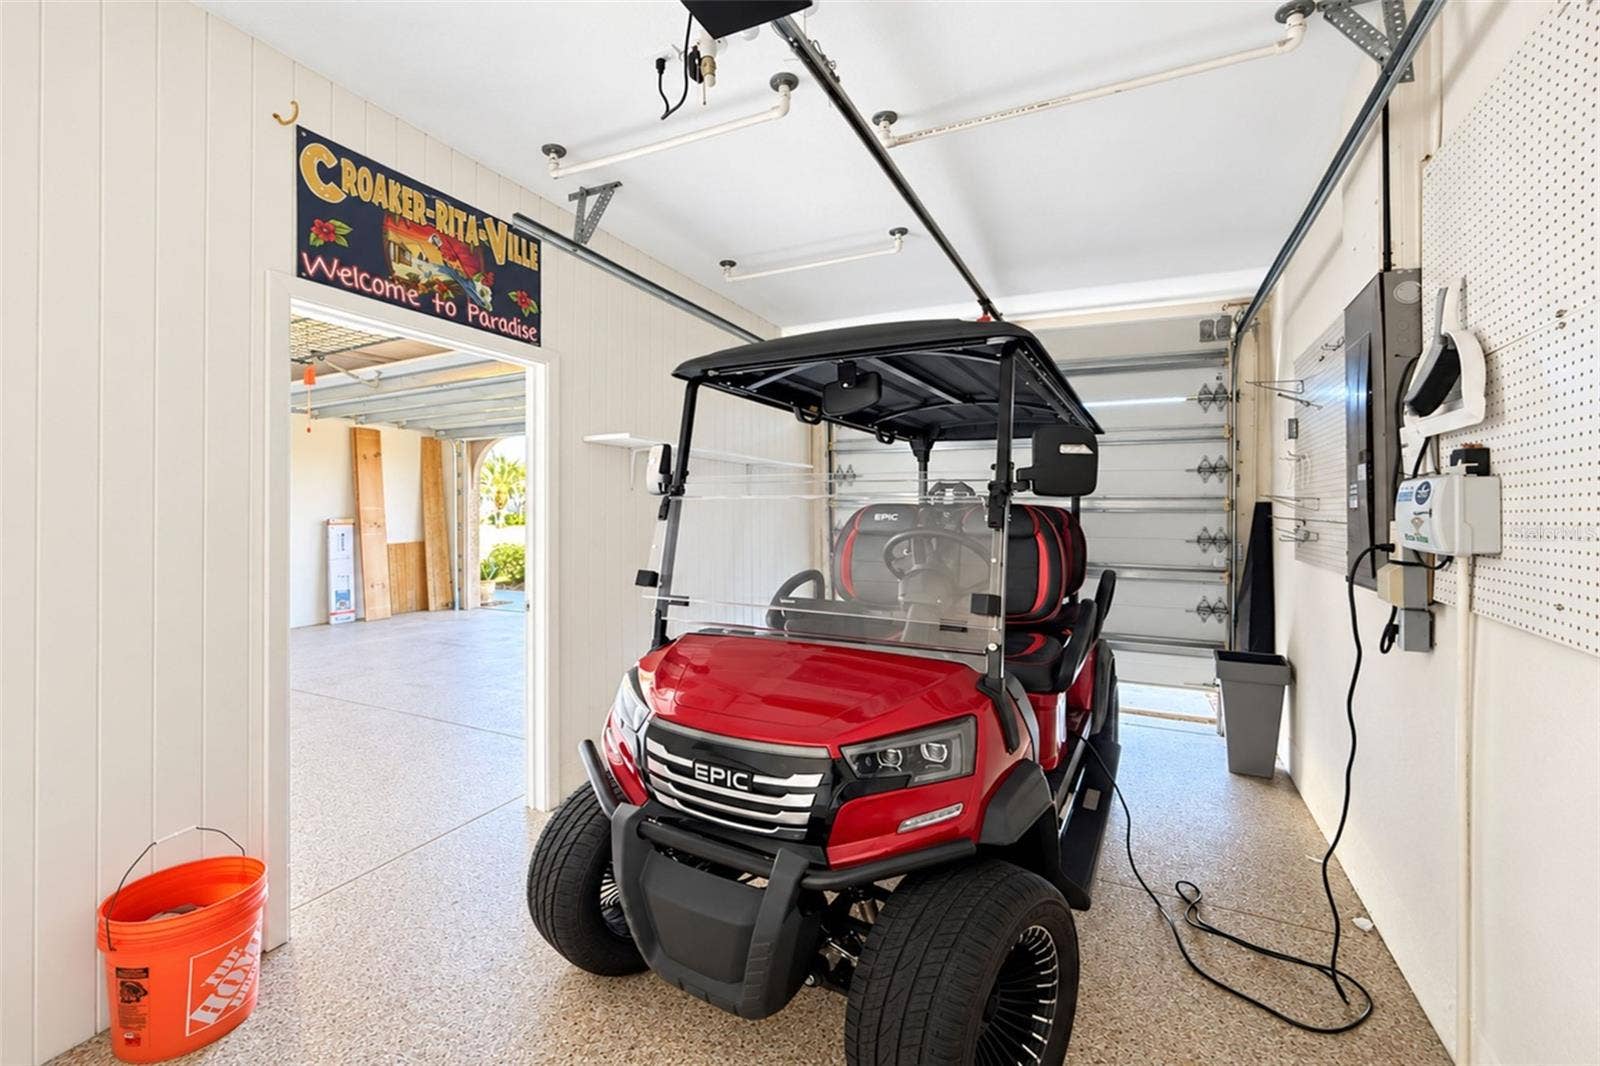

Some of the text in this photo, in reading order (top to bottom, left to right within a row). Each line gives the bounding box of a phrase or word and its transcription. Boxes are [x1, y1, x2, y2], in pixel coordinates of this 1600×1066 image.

[301, 251, 538, 342] Welcome to Paradise
[874, 512, 899, 522] EPIC
[694, 764, 749, 791] EPIC
